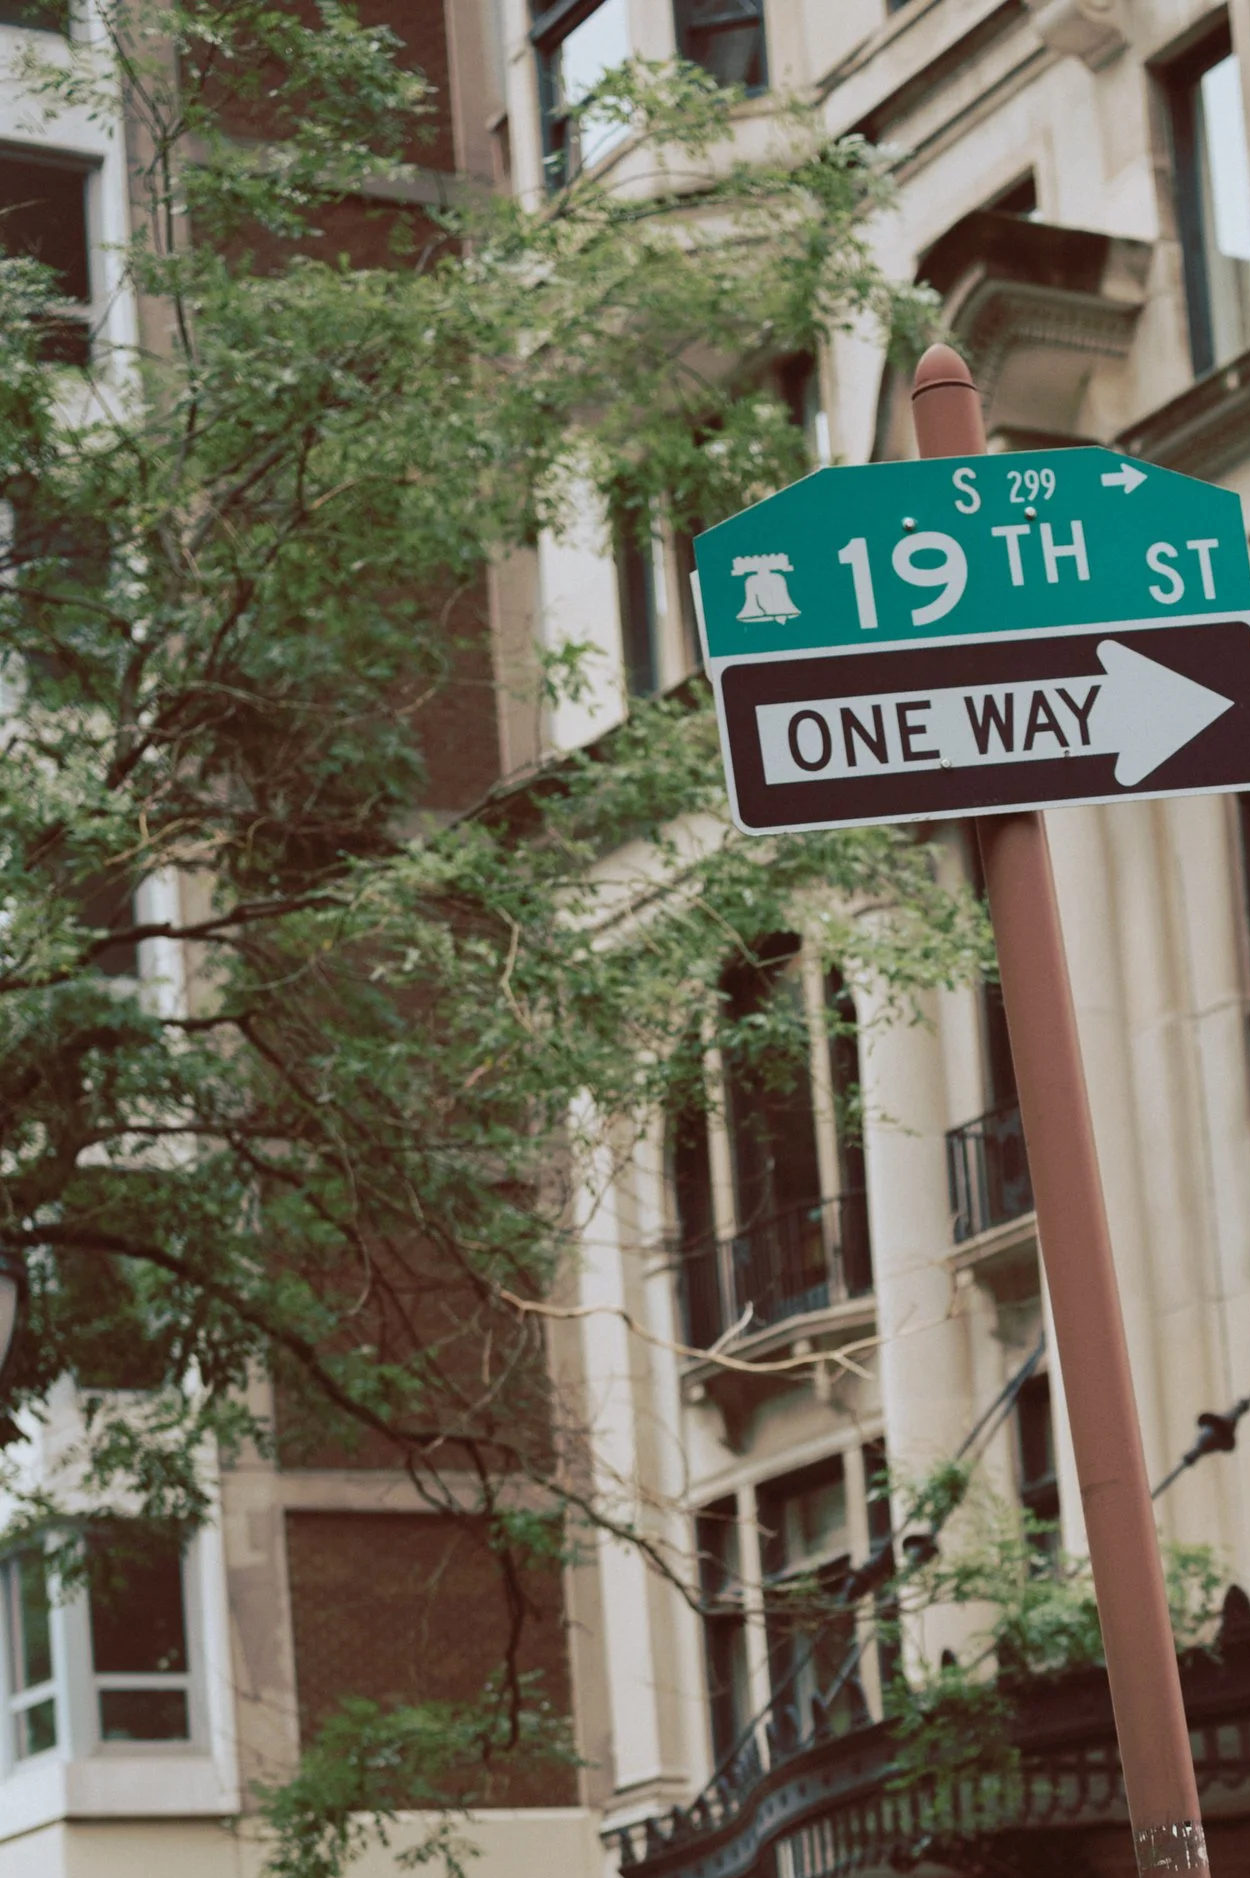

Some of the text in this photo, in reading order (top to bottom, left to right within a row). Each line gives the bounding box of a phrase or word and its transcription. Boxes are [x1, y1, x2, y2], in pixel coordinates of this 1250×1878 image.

[952, 467, 1057, 514] S 299
[1146, 538, 1220, 604] ST
[787, 684, 1104, 772] ONE WAY
